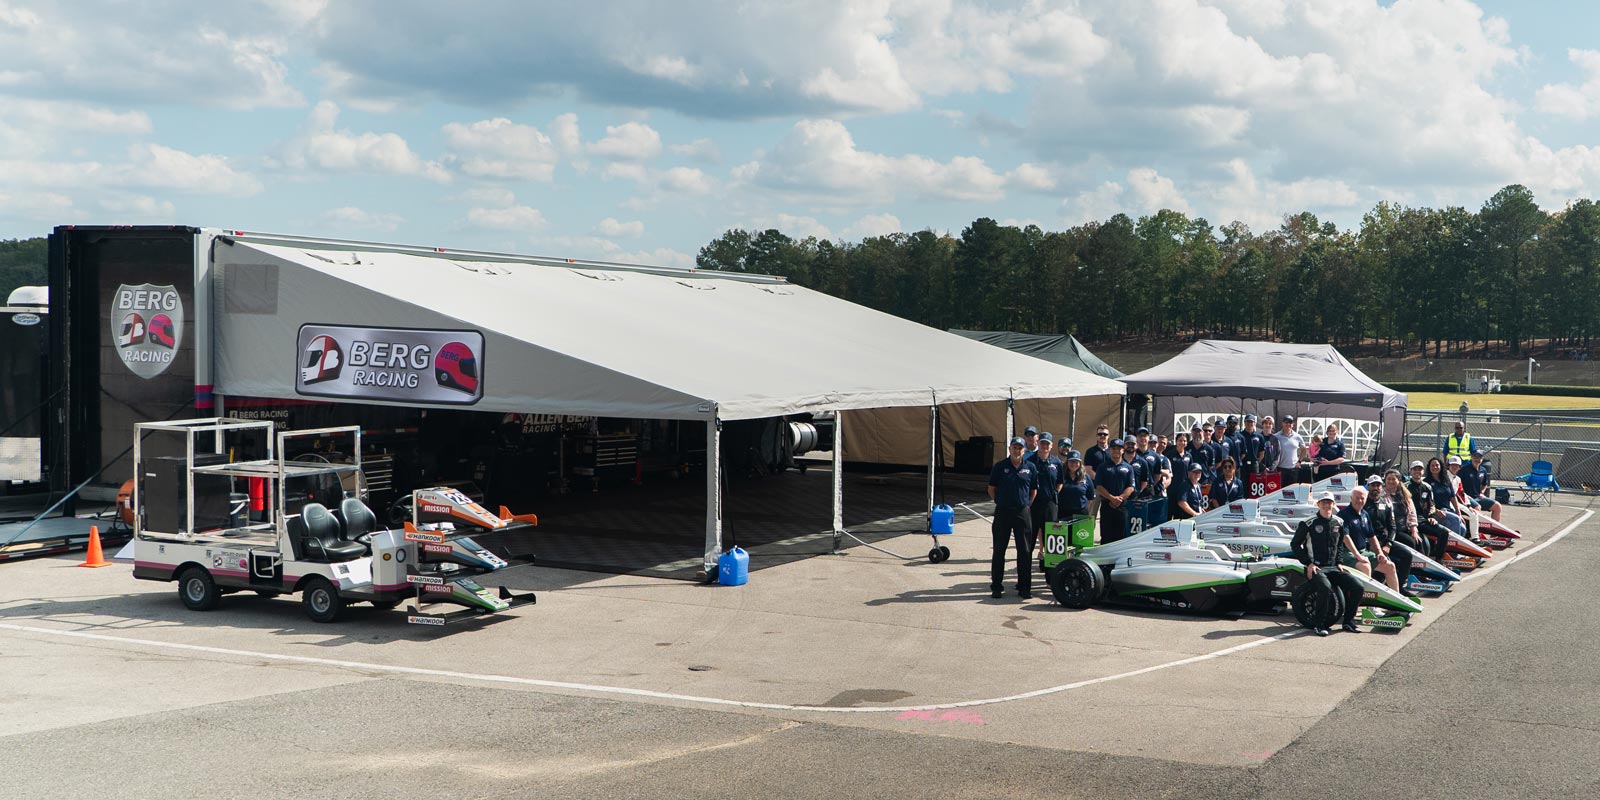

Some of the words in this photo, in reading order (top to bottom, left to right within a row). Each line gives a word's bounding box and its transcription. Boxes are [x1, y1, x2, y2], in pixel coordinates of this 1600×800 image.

[119, 290, 177, 310] BERG
[124, 350, 170, 363] RACING
[349, 341, 430, 369] BERG
[441, 350, 460, 361] BERG
[353, 370, 419, 388] RACING
[239, 410, 259, 419] BERG
[260, 409, 289, 418] RACING
[524, 413, 563, 425] ALLEN
[522, 424, 556, 433] RACING
[1251, 482, 1265, 496] 98
[424, 505, 450, 513] mission
[1130, 516, 1143, 534] 23
[424, 544, 450, 553] mission
[1047, 534, 1065, 554] 08
[1221, 543, 1242, 552] ASS
[425, 584, 451, 593] mission
